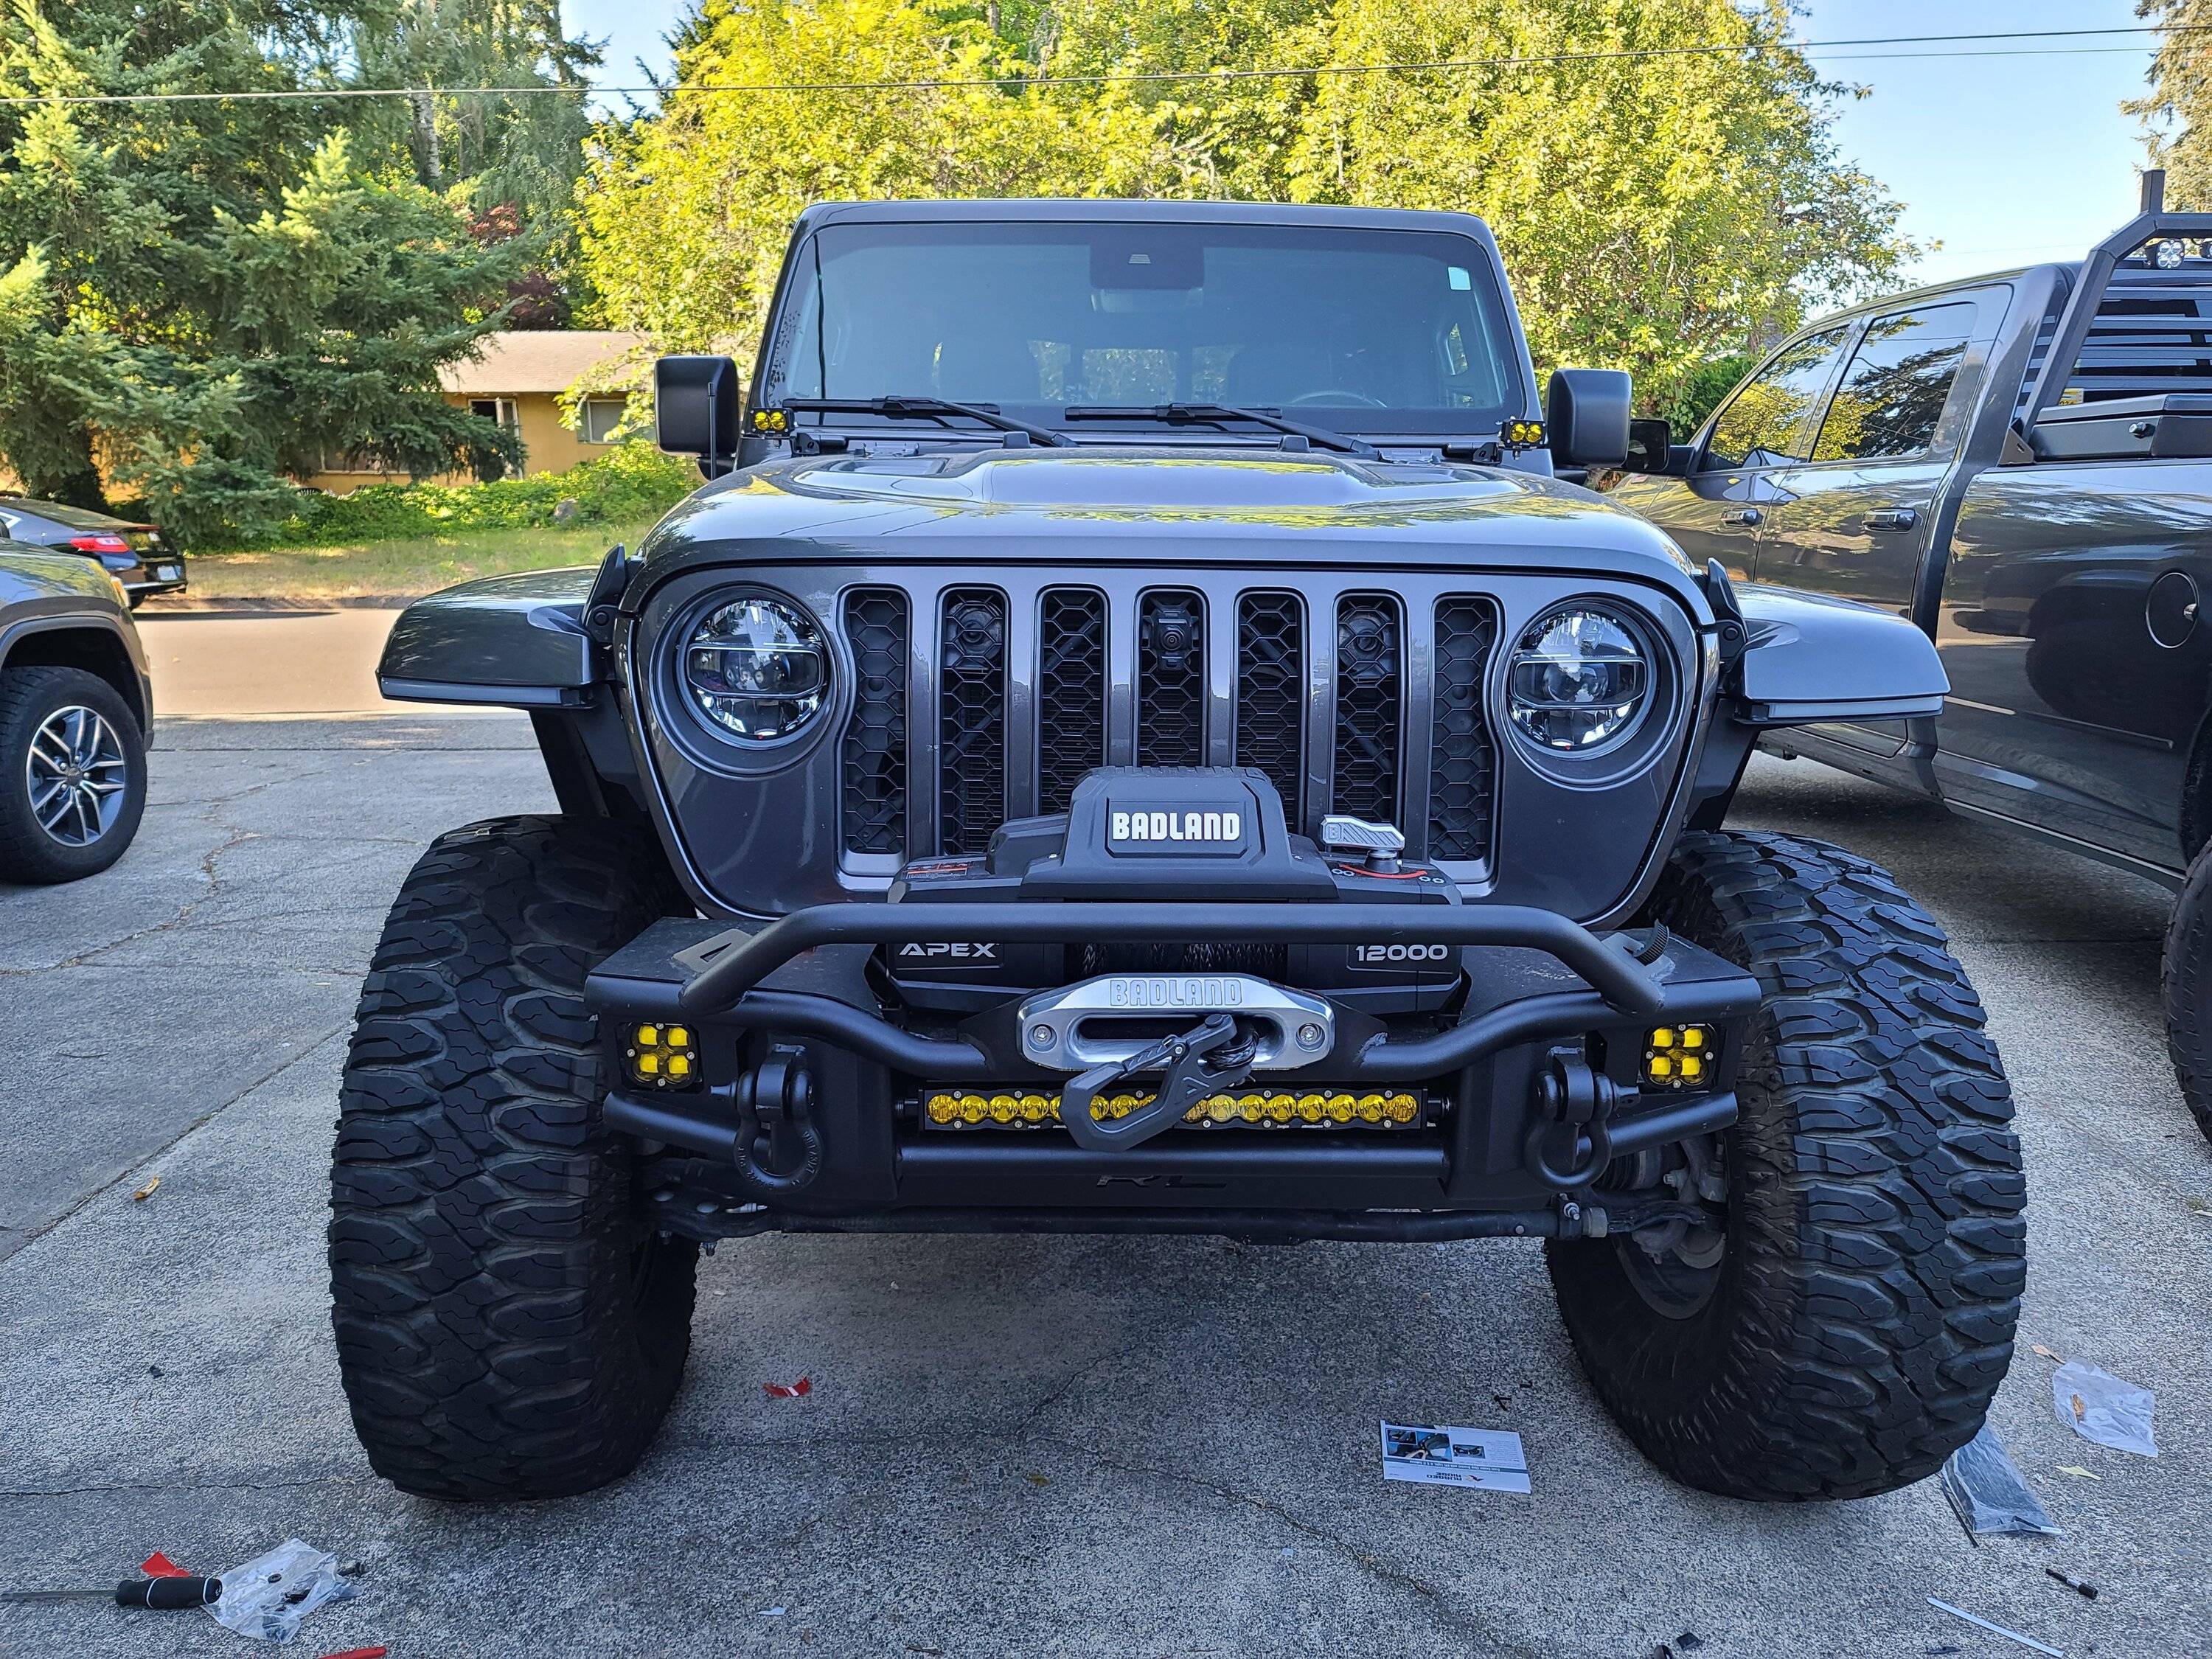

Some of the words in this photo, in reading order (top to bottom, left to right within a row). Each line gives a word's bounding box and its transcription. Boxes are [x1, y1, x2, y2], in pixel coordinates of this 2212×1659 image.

[1112, 812, 1240, 841] BADLAND
[899, 943, 996, 958] APEX
[1355, 945, 1448, 961] 12000
[1110, 979, 1242, 1006] BADLAND
